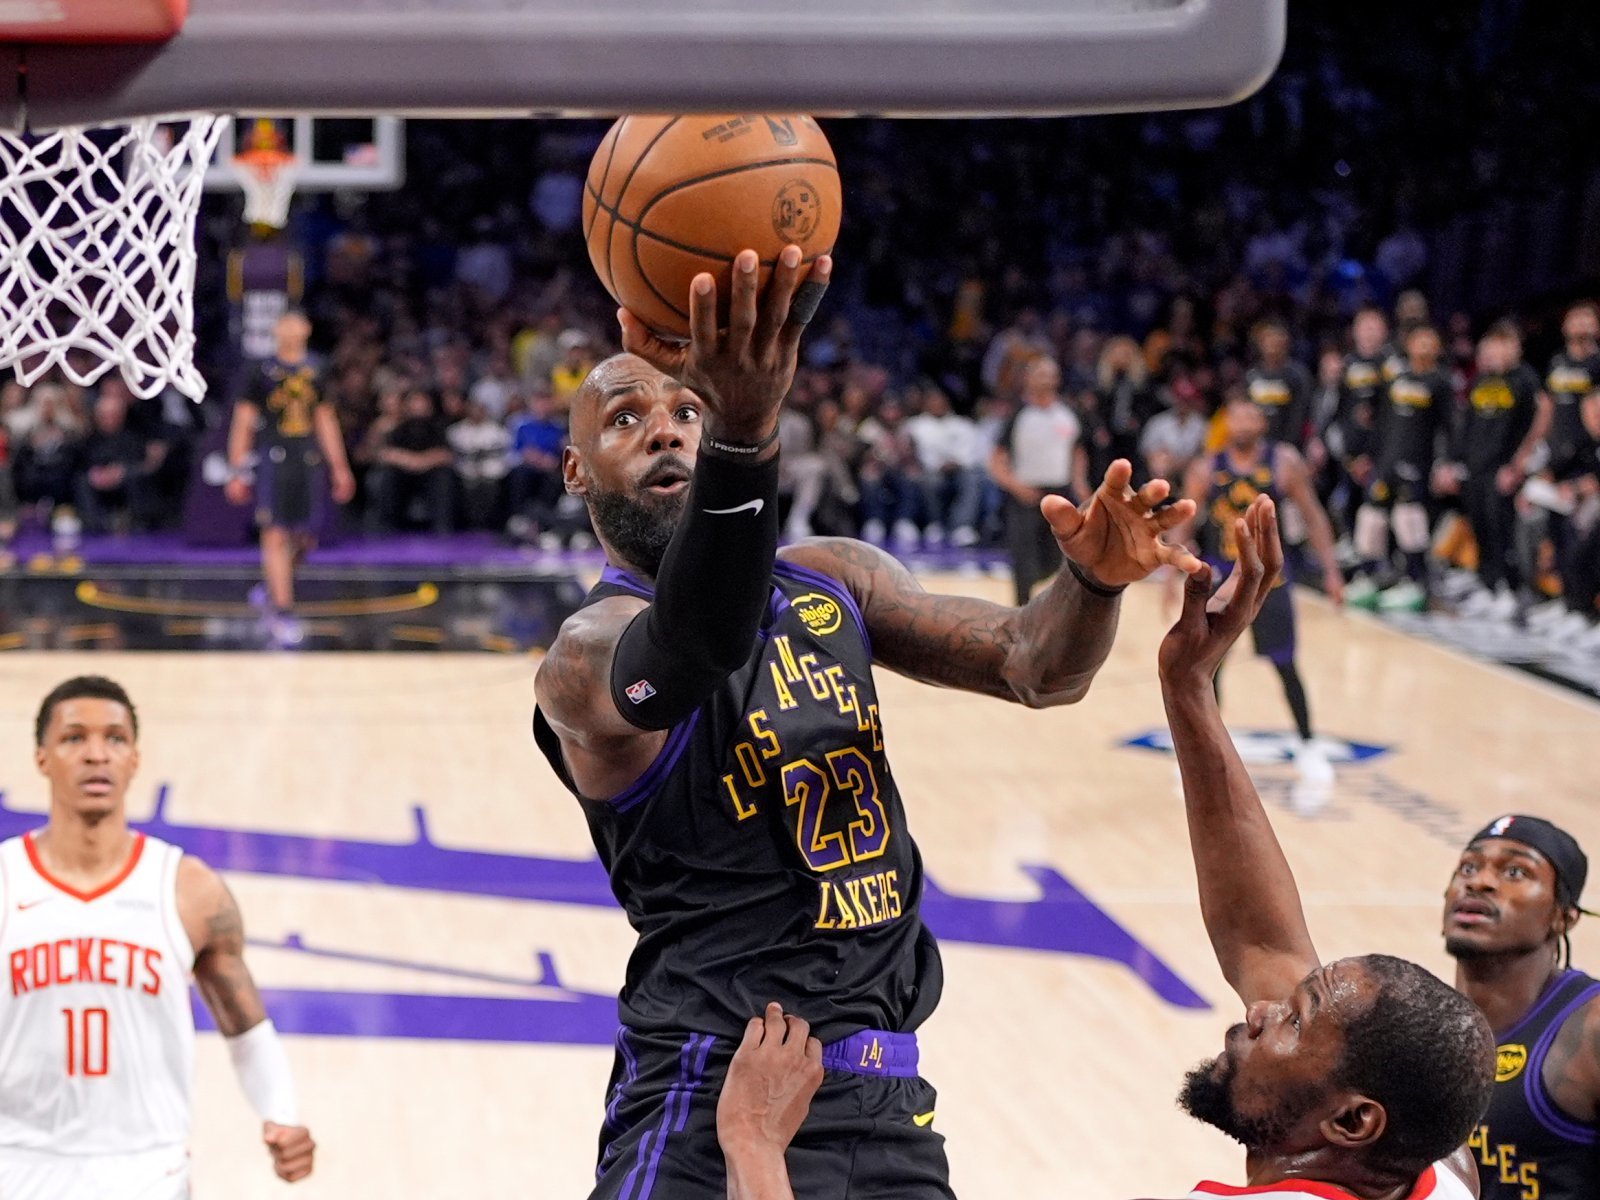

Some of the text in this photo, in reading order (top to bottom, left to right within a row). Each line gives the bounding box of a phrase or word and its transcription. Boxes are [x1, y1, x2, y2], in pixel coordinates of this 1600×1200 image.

[722, 635, 884, 820] LOS ANGELE
[781, 746, 891, 872] 23
[814, 869, 902, 929] LAKERS
[10, 937, 162, 998] ROCKETS
[62, 1007, 108, 1077] 10
[859, 1037, 883, 1069] LAL
